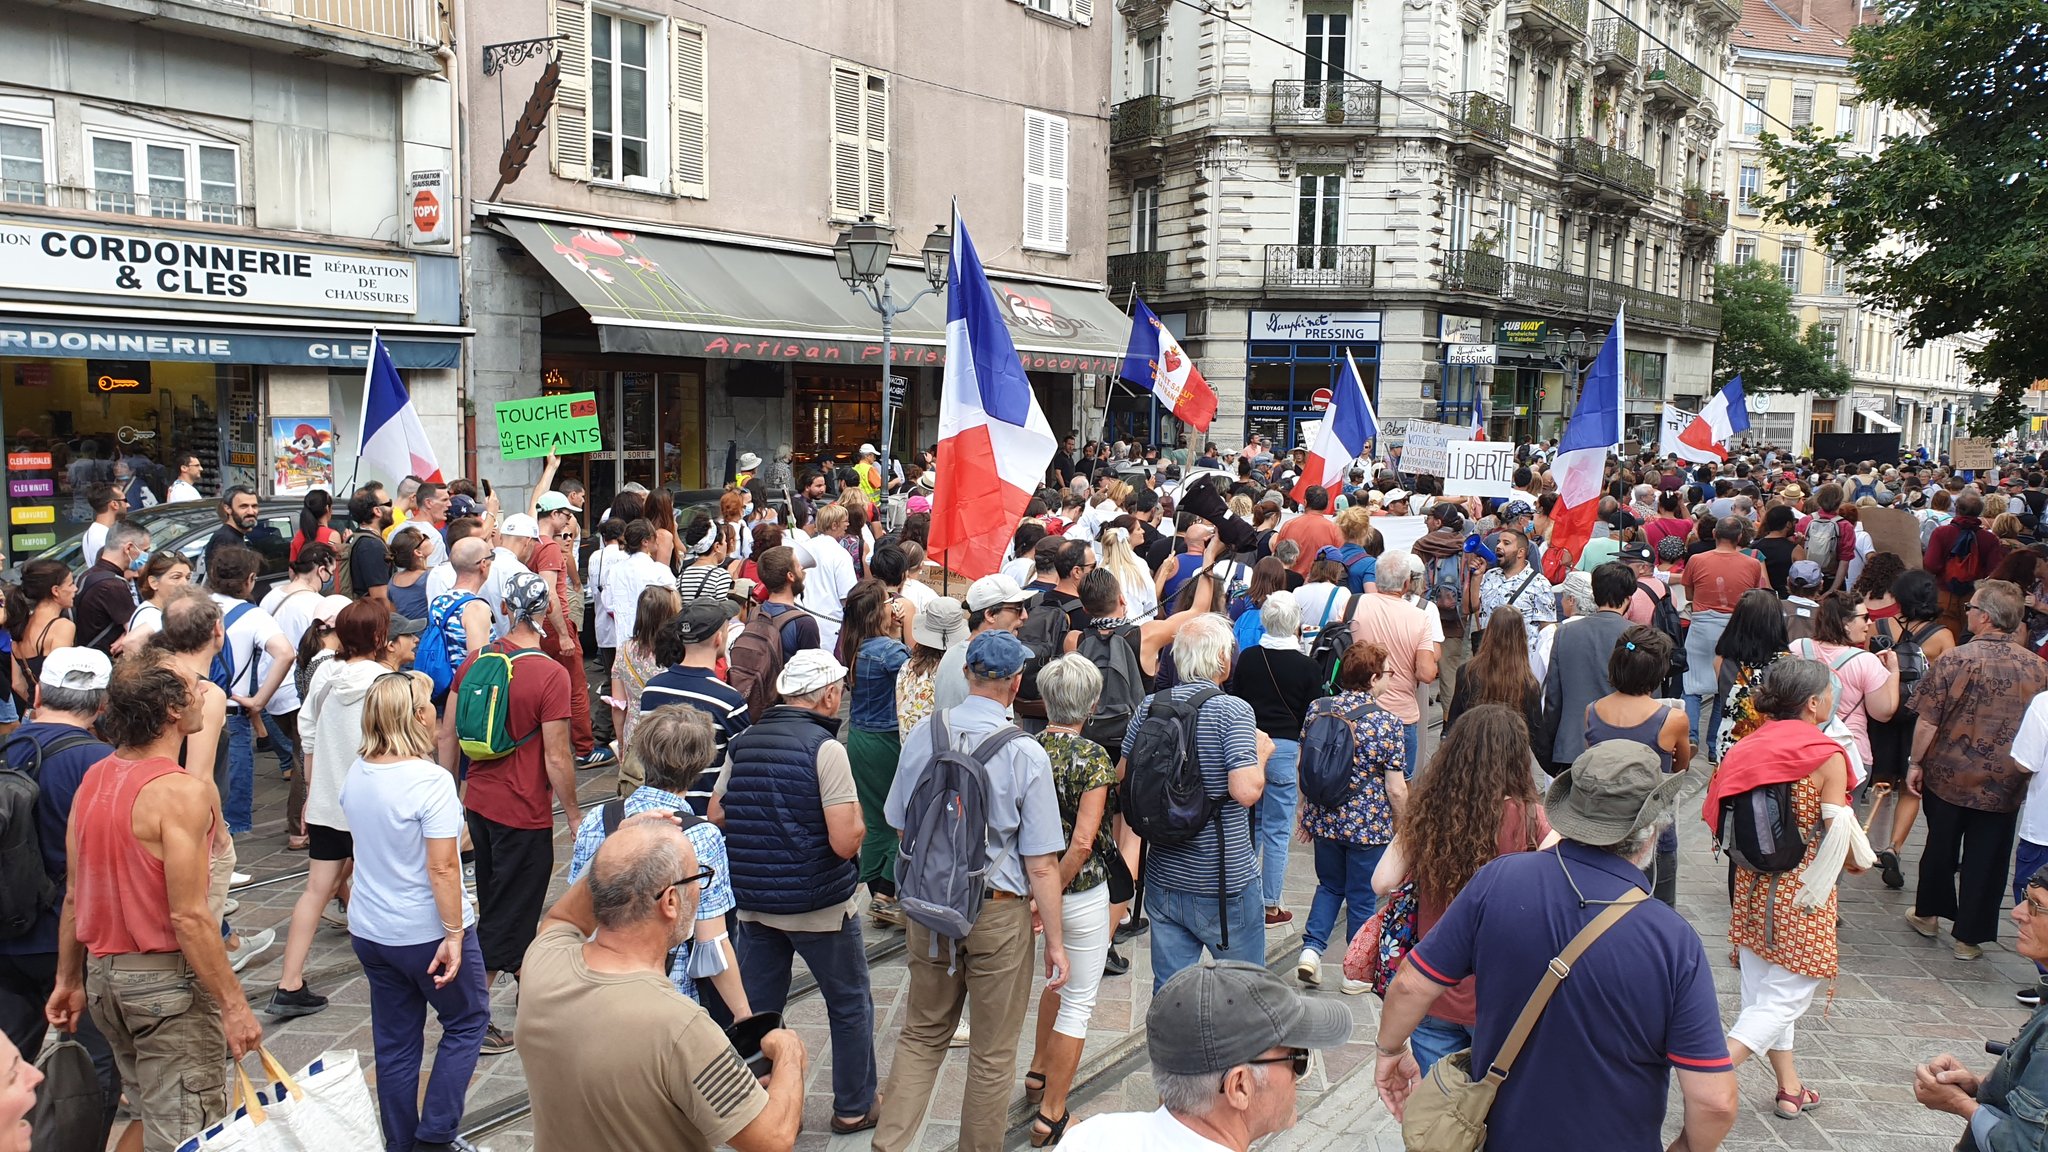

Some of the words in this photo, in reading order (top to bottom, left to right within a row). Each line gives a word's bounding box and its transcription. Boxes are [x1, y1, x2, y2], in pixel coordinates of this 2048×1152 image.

[414, 205, 438, 218] TOPY
[41, 231, 312, 277] CORDONNERIE
[324, 260, 409, 278] RÉPARATION
[115, 265, 143, 290] &
[156, 268, 248, 297] CLES
[358, 278, 377, 289] DE
[324, 288, 409, 304] CHAUSSURES
[1500, 321, 1545, 331] SUBWAY
[1305, 328, 1364, 339] PRESSING
[1459, 333, 1480, 343] PRESSING
[704, 336, 840, 360] Artisan
[1450, 355, 1493, 364] PRESSING
[496, 403, 568, 424] TOUCHE
[571, 402, 596, 414] PAS
[1409, 421, 1432, 434] VOTRE
[501, 431, 514, 454] LES
[516, 427, 600, 450] ENFANTS
[1408, 433, 1431, 447] VOTRE
[1405, 446, 1431, 459] VOTRE
